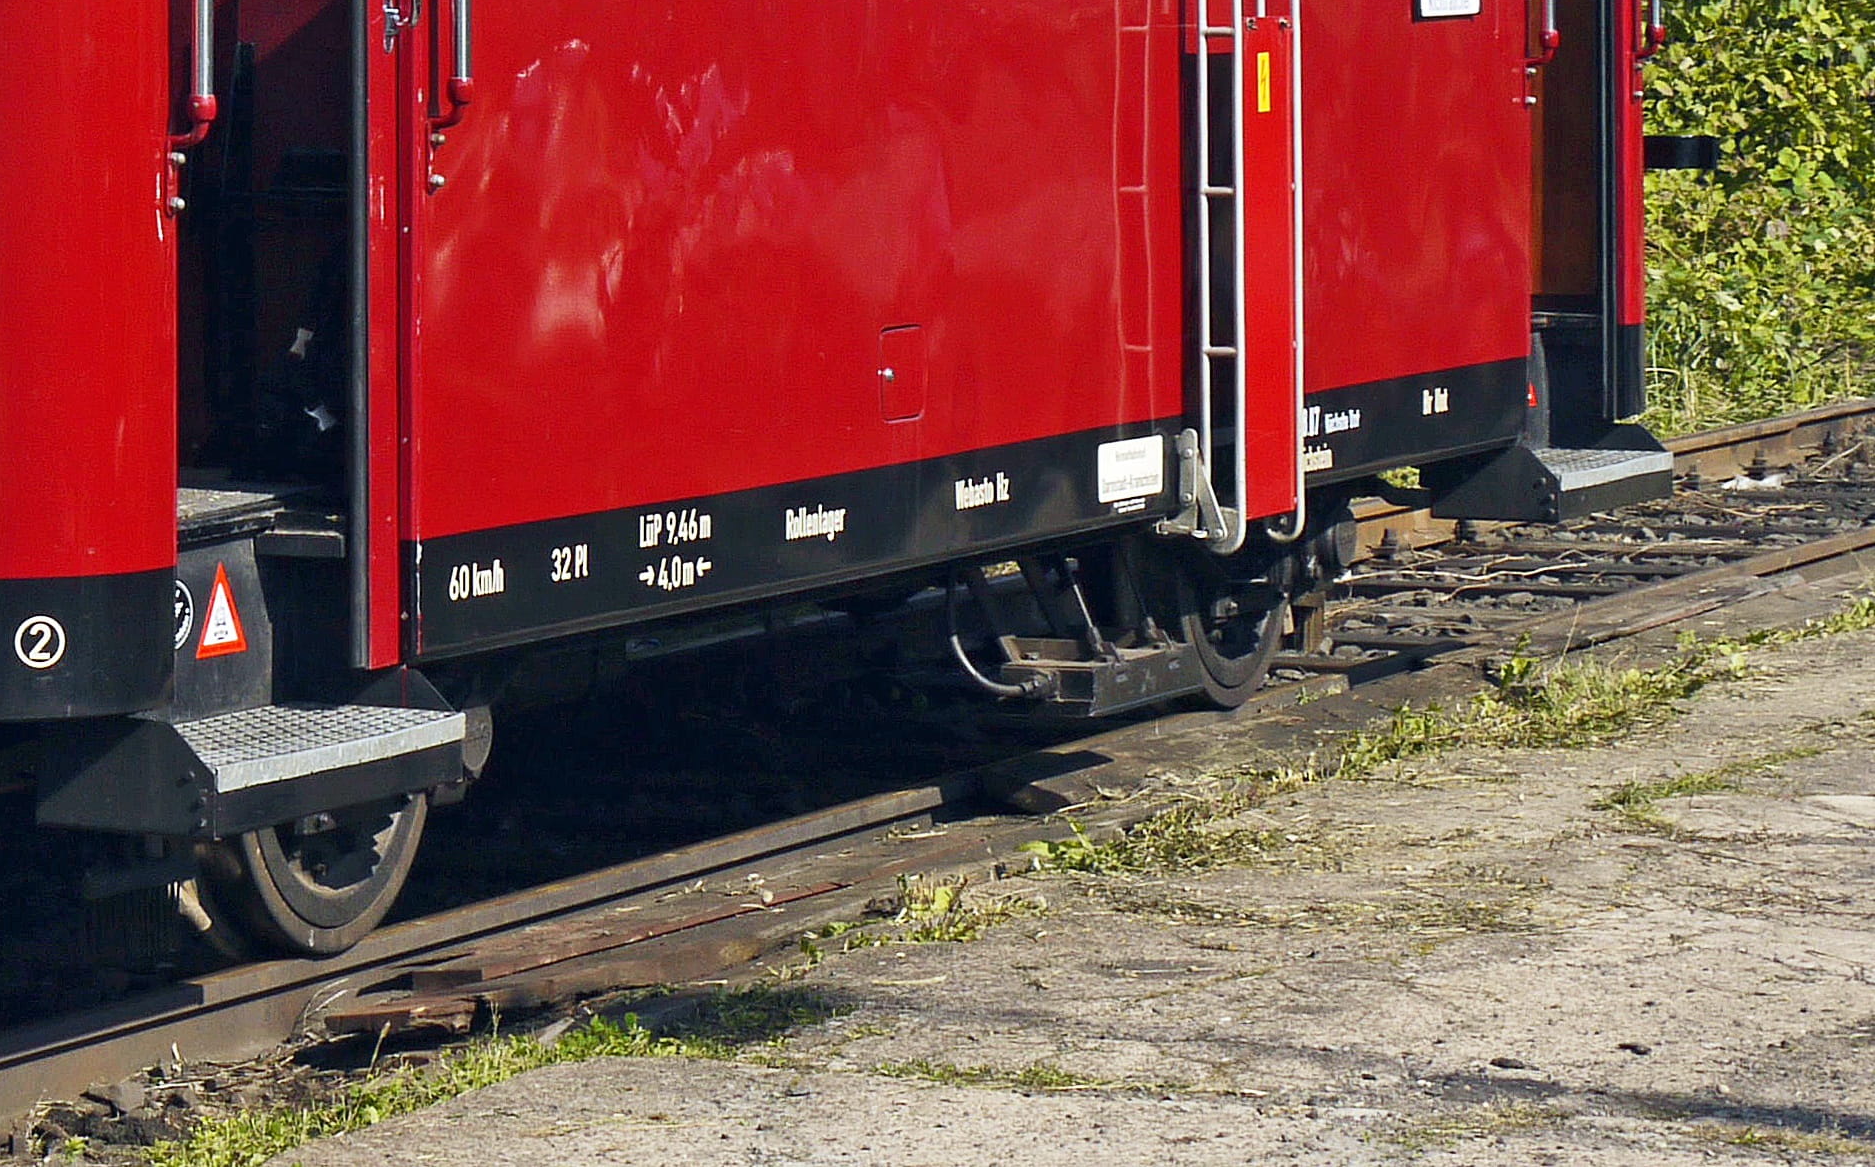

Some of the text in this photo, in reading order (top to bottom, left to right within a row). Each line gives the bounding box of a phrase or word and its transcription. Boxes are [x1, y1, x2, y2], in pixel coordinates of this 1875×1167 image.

[954, 476, 995, 510] Webasto
[785, 503, 846, 542] Rollenlager
[448, 558, 505, 601] 60 km/h
[550, 543, 589, 582] 32 Pl
[29, 623, 52, 660] 2
